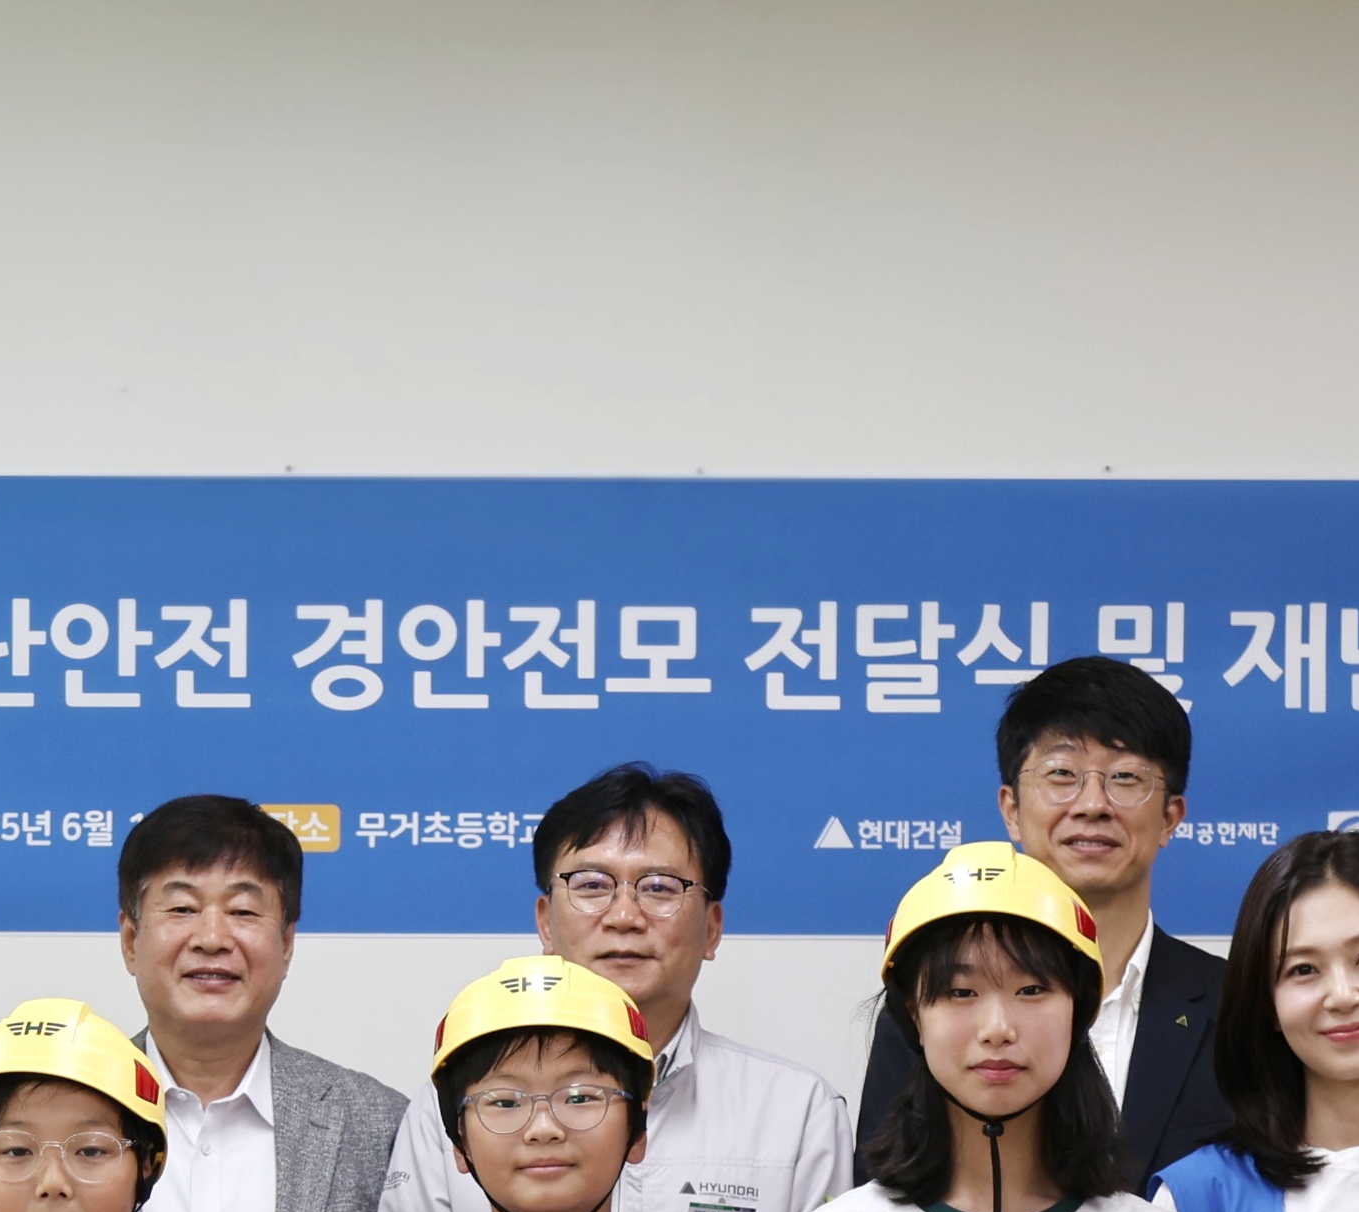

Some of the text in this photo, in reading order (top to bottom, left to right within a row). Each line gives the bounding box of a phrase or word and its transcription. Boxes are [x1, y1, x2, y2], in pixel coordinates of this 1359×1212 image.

[292, 599, 712, 712] 경안전모
[744, 600, 1049, 714] 전달식
[61, 810, 114, 847] 6월
[858, 819, 962, 850] 현대건설
[1169, 822, 1280, 846] 회공헌재단
[699, 1181, 759, 1198] HYUNDAI
